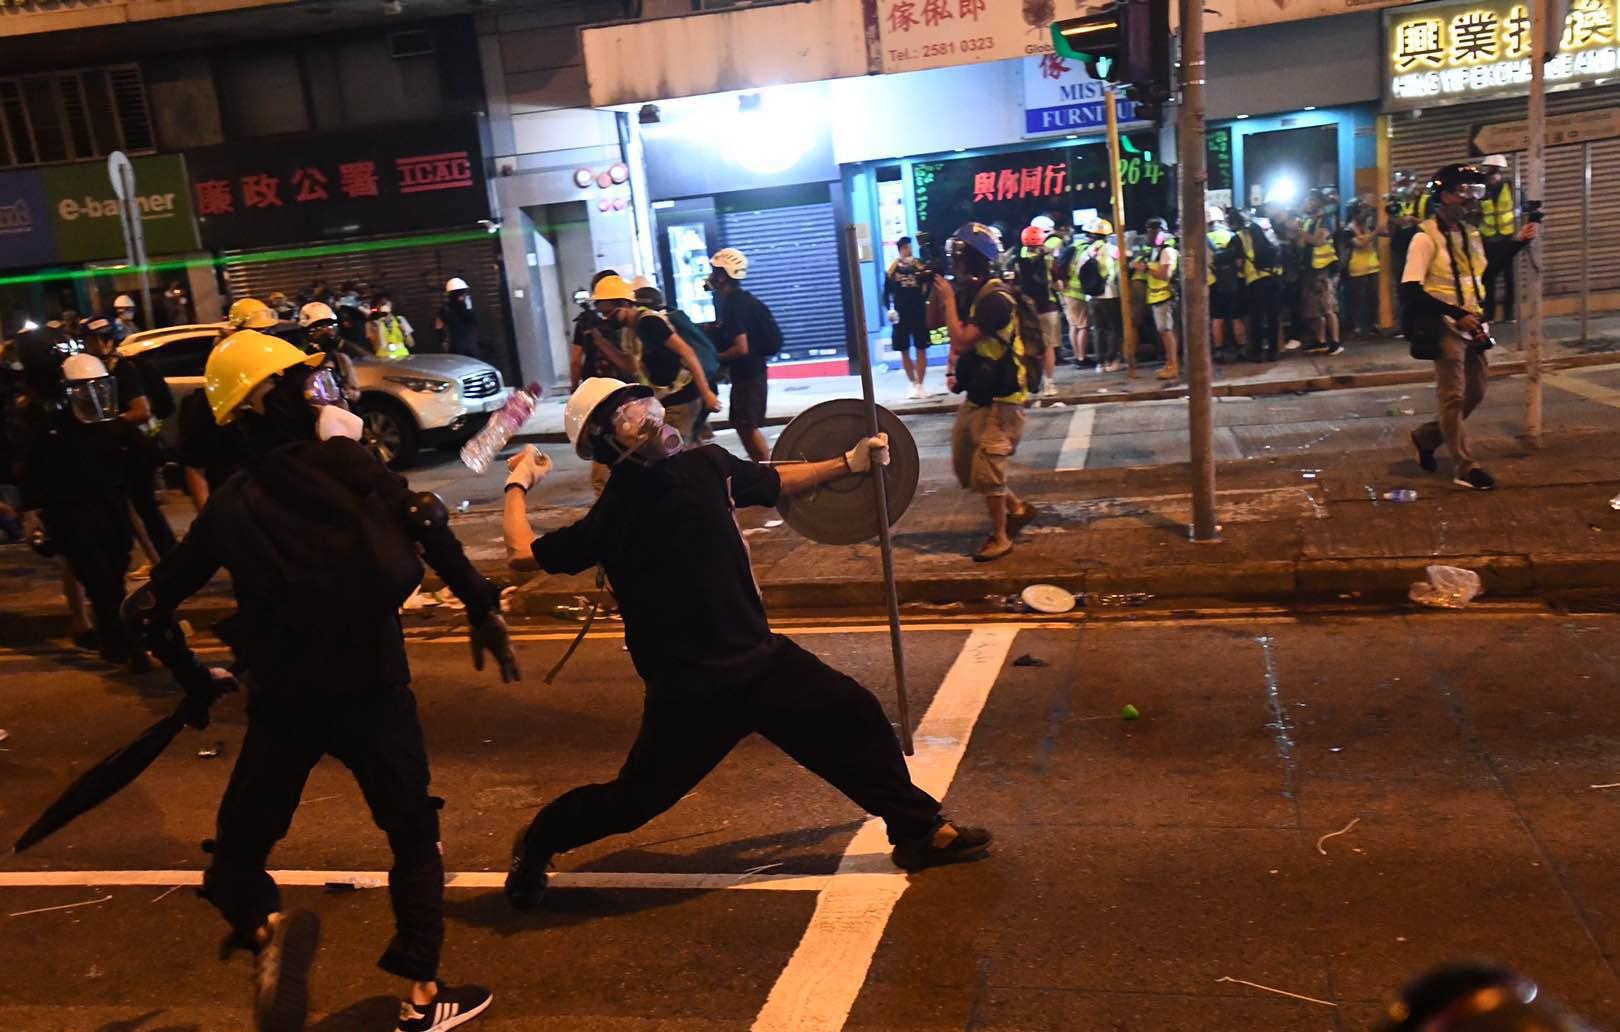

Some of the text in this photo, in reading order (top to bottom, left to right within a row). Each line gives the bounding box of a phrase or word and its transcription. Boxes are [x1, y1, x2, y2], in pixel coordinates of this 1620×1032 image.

[922, 41, 956, 57] 2581
[960, 36, 995, 52] 0323
[195, 158, 473, 215] 廉政公署 ICAC
[58, 191, 176, 221] e-baner
